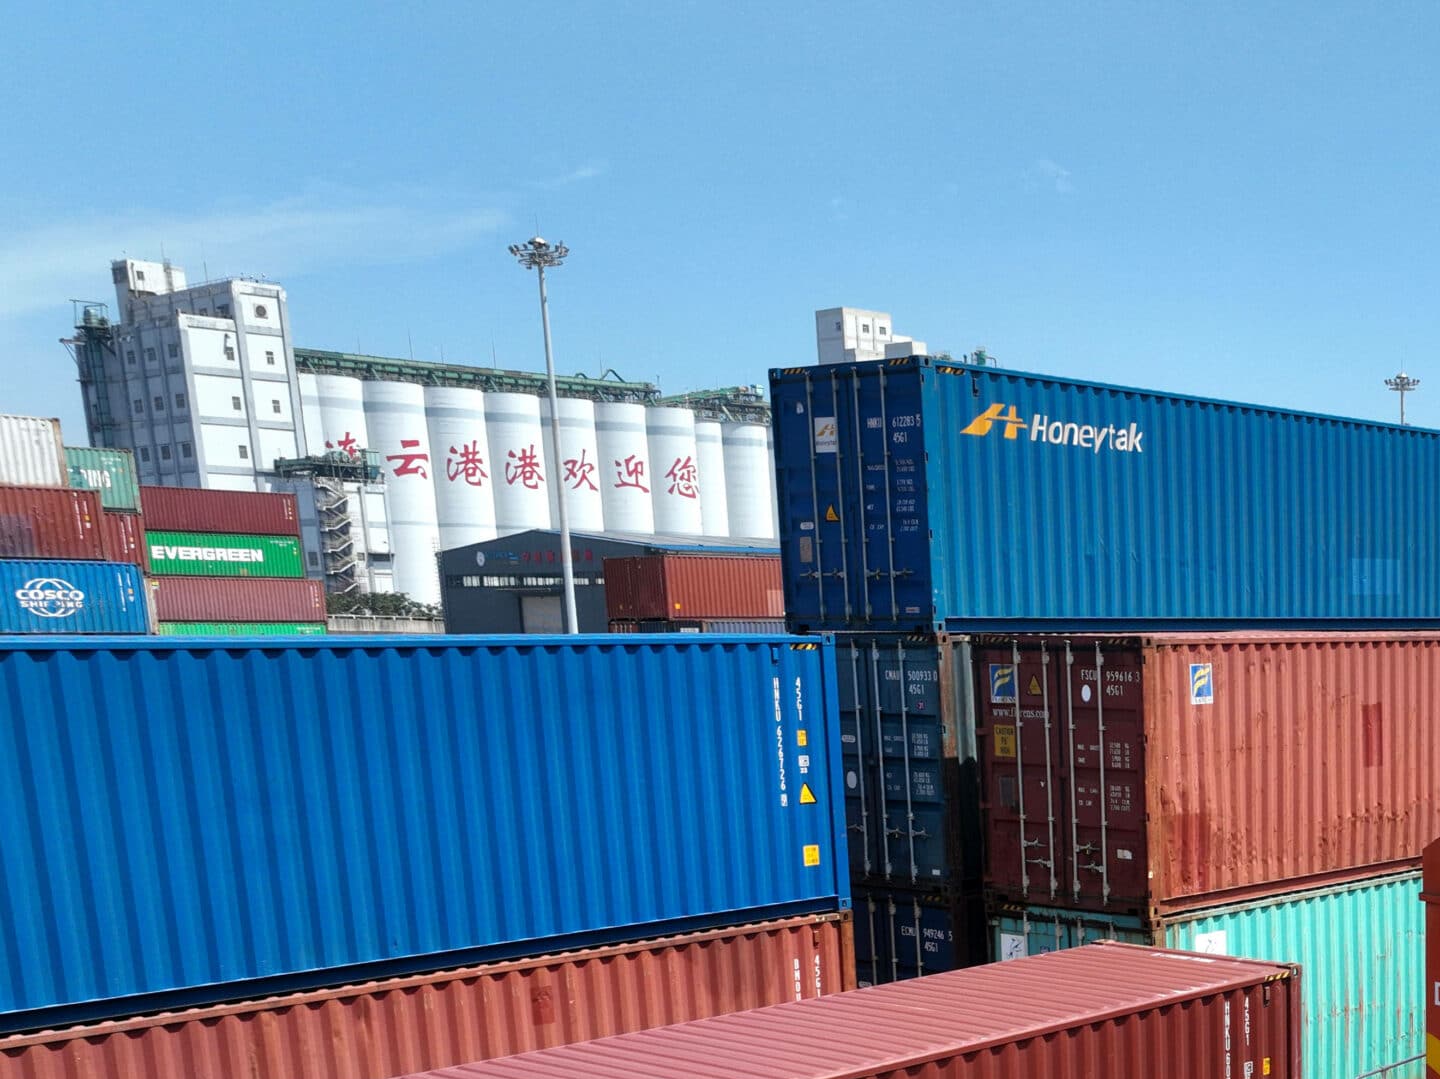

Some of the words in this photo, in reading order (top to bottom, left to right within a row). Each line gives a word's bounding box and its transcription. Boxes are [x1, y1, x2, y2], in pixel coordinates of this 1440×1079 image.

[892, 415, 915, 428] 612283
[893, 431, 907, 444] 45G1
[1030, 413, 1144, 455] Honeytak
[151, 545, 264, 563] EVERGREEN
[15, 588, 85, 602] COSCO
[907, 670, 931, 681] 500933
[1106, 670, 1133, 682] 959616
[1136, 672, 1141, 683] 3
[908, 683, 925, 695] 45G1
[1106, 685, 1124, 697] 45G1
[773, 677, 781, 722] HNKU
[795, 677, 803, 721] 45G1
[776, 725, 786, 791] 626726
[922, 928, 944, 940] 949246
[924, 941, 938, 953] 45G1
